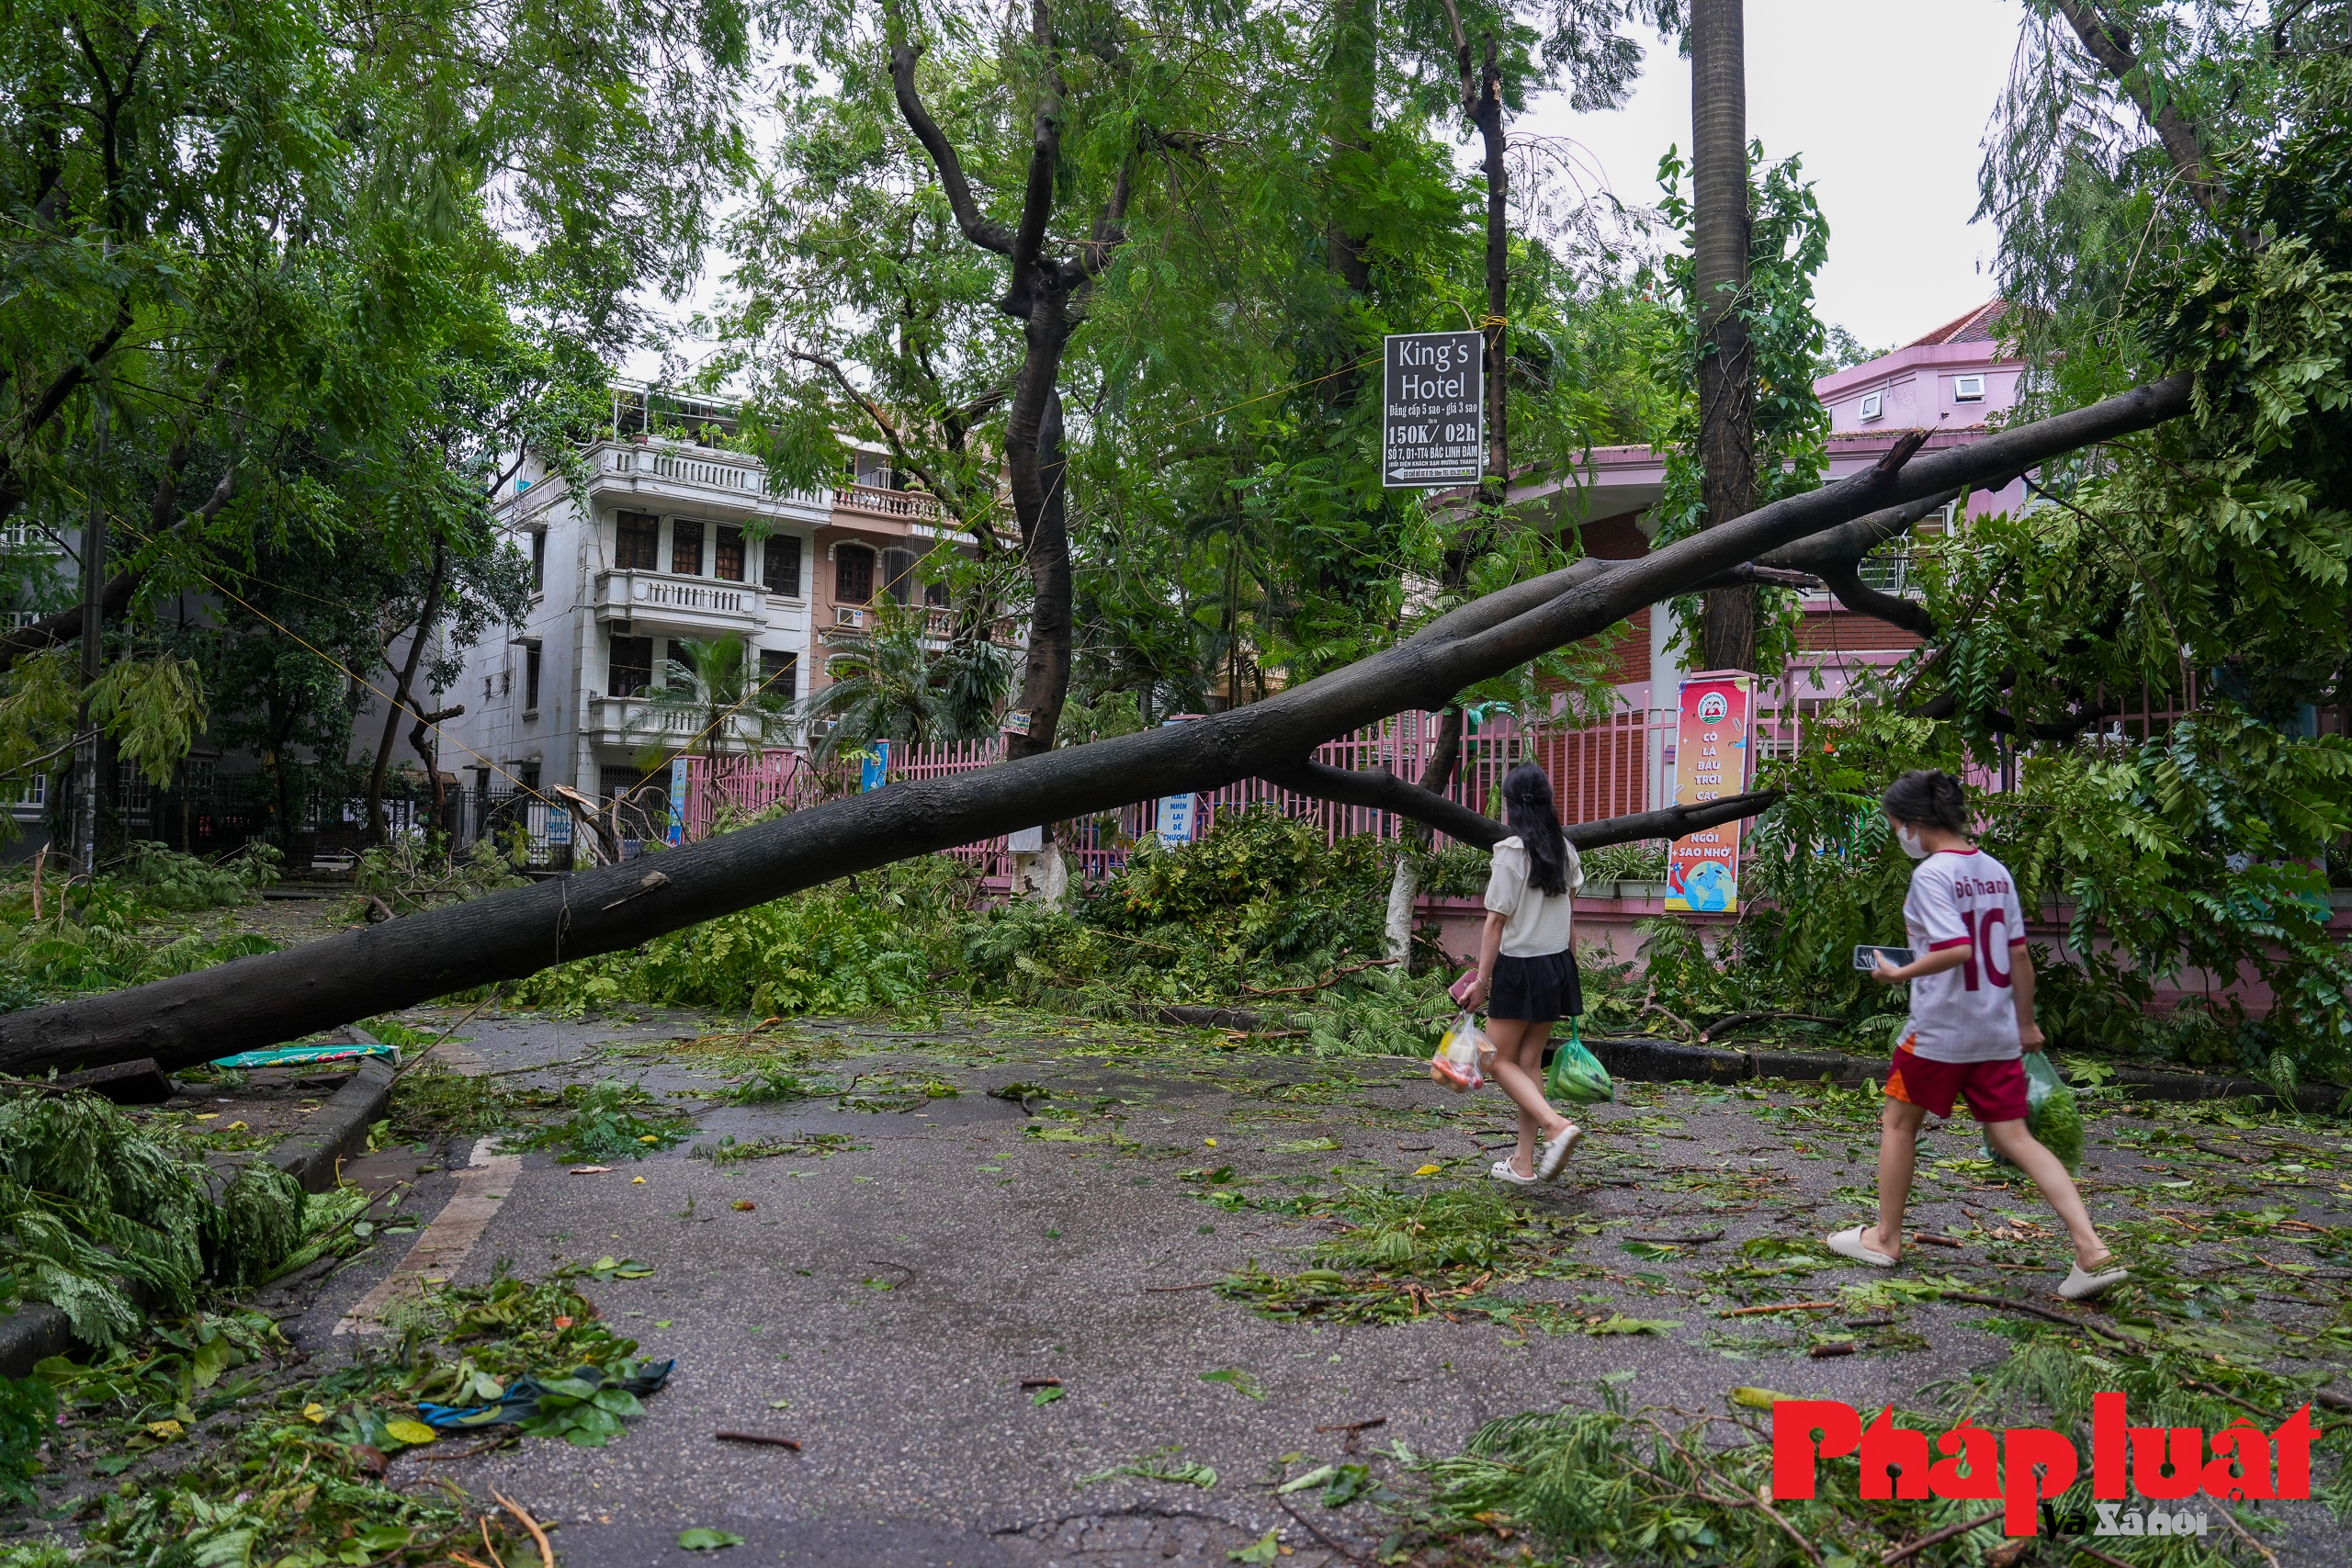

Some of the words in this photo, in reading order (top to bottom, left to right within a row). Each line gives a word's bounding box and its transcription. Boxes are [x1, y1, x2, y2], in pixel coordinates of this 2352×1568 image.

[1399, 338, 1468, 372] King's
[1402, 372, 1464, 400] Hotel
[1408, 403, 1420, 417] cấp
[1422, 403, 1427, 415] 5
[1429, 405, 1440, 414] sao
[1446, 401, 1457, 416] giá
[1459, 401, 1464, 413] 3
[1465, 403, 1477, 413] sao
[1389, 424, 1440, 445] 150K/
[1445, 423, 1476, 442] 02h
[1388, 445, 1397, 459] SỐ
[1398, 448, 1405, 460] 7,
[1407, 446, 1429, 459] D1-TT4
[1430, 443, 1443, 458] BẮC
[1445, 446, 1460, 457] LINH
[1462, 443, 1477, 457] ĐÀM
[1702, 731, 1718, 742] CÔ
[1702, 745, 1717, 756] LÀ
[1697, 758, 1721, 771] BẦU
[1694, 773, 1722, 784] TRỜI
[1696, 789, 1719, 801] CÁC
[1170, 801, 1187, 809] NHÌN
[546, 818, 571, 833] THUỐC
[1690, 832, 1719, 843] NGÔI
[1679, 847, 1702, 857] SAO
[1961, 908, 2011, 992] 10
